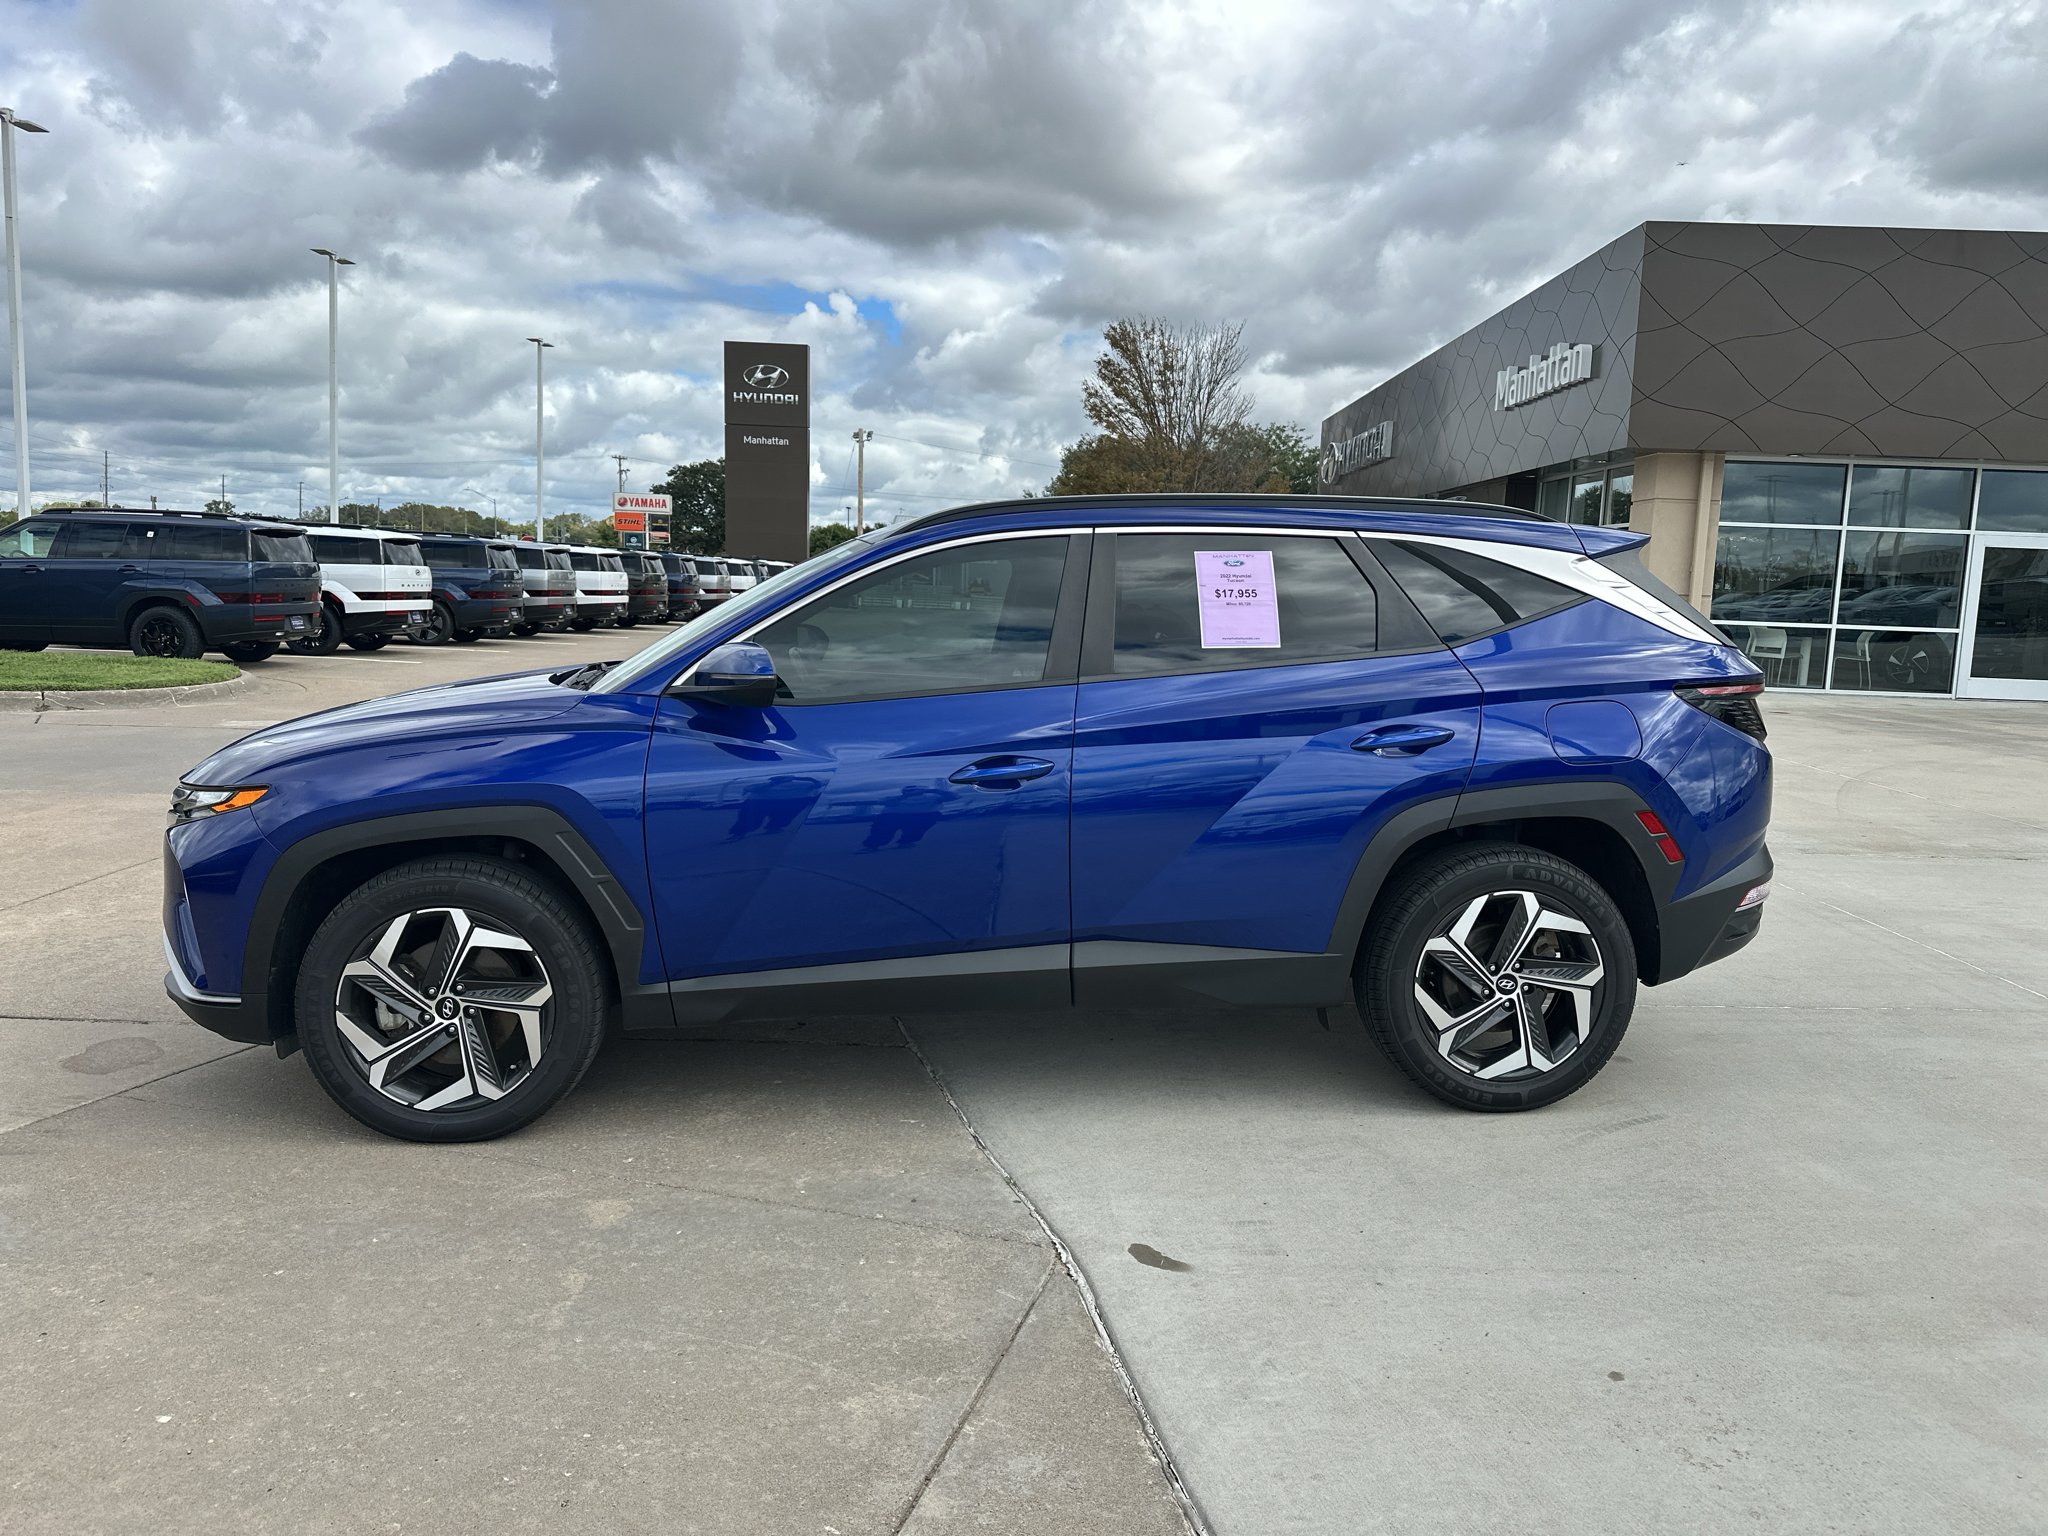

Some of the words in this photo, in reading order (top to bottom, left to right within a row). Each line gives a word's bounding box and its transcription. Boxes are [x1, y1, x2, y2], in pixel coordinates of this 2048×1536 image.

[1495, 342, 1593, 412] Manhattan
[733, 391, 799, 405] HYUNDAI
[743, 435, 790, 446] Manhattan
[628, 498, 667, 508] YAMAHA
[617, 518, 641, 526] STIHL
[1214, 589, 1258, 598] $17,955
[1523, 868, 1606, 918] ADVANTA
[551, 942, 580, 1024] ER-800
[1423, 1063, 1493, 1105] ER-800
